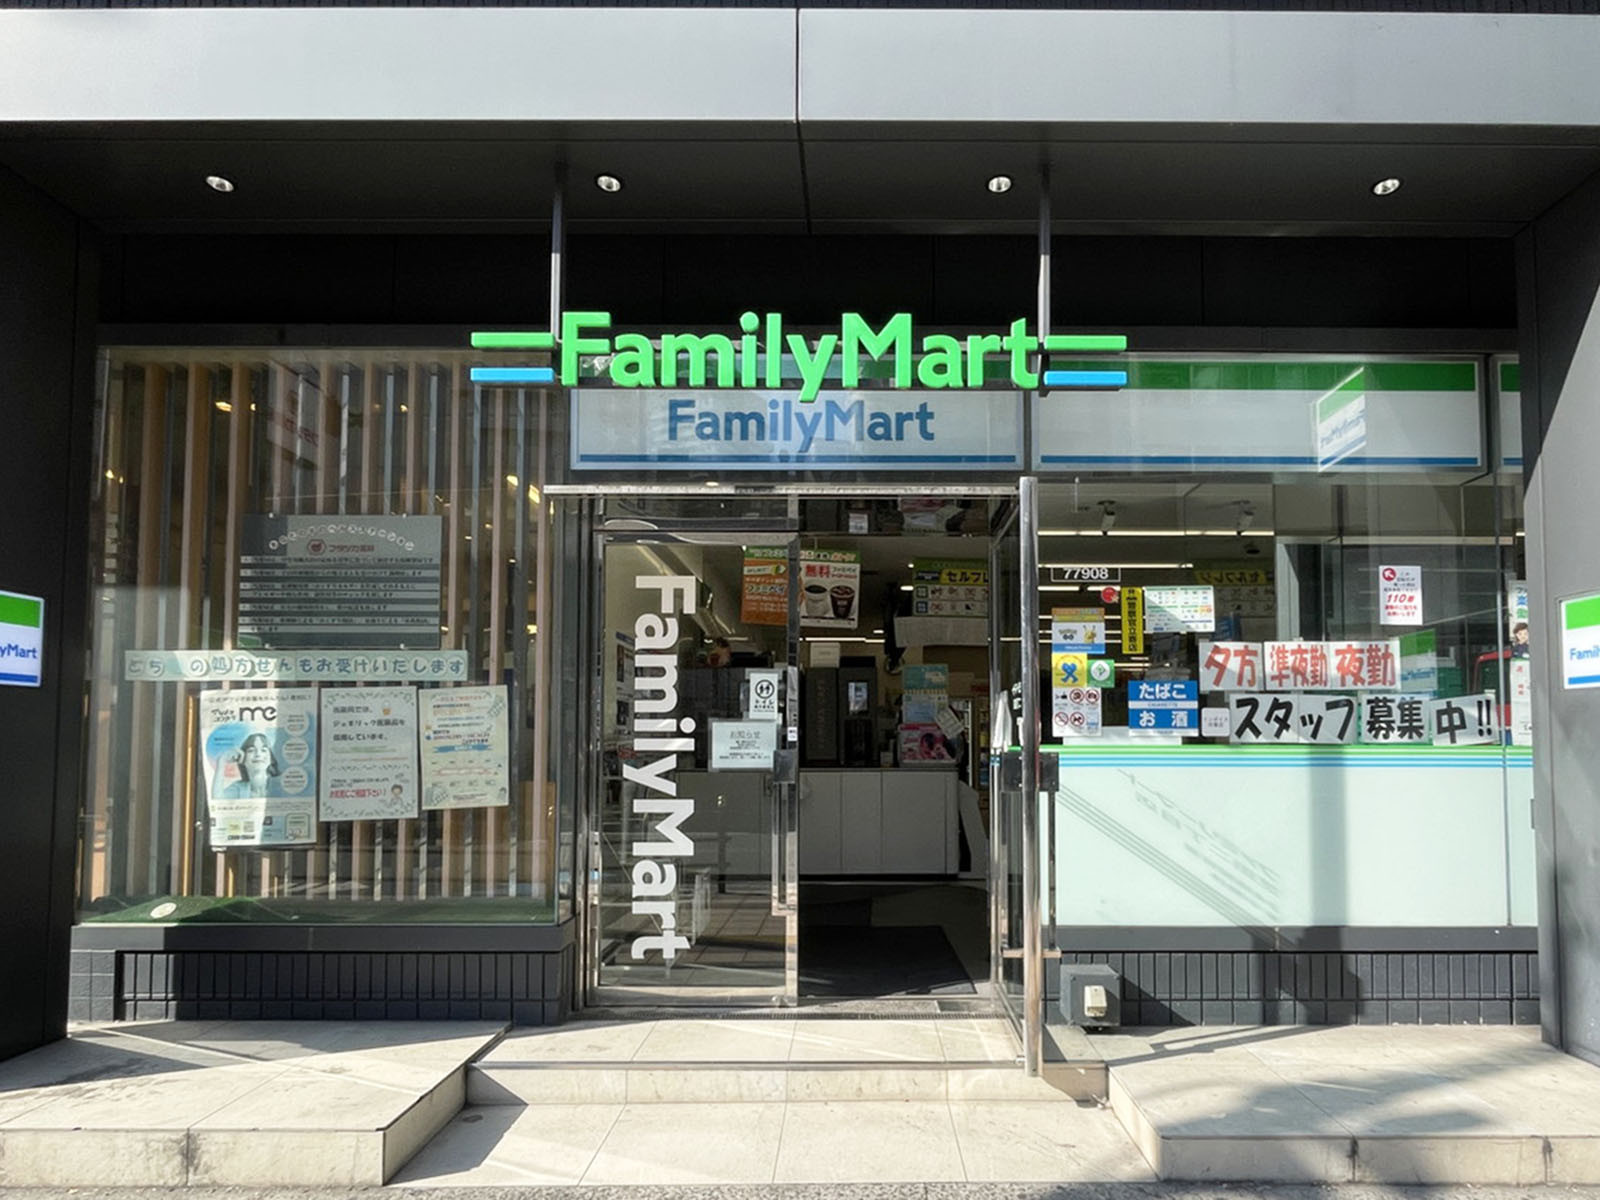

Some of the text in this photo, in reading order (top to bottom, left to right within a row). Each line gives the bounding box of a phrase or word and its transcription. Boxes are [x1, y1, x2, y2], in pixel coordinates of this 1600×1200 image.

[561, 311, 1039, 402] FamilyMart
[668, 399, 935, 453] FamilyMart
[1063, 567, 1109, 580] 77908
[1204, 644, 1258, 687] 夕方
[1139, 683, 1187, 699] たばこ
[239, 706, 277, 721] me
[622, 575, 697, 961] FamilyMart
